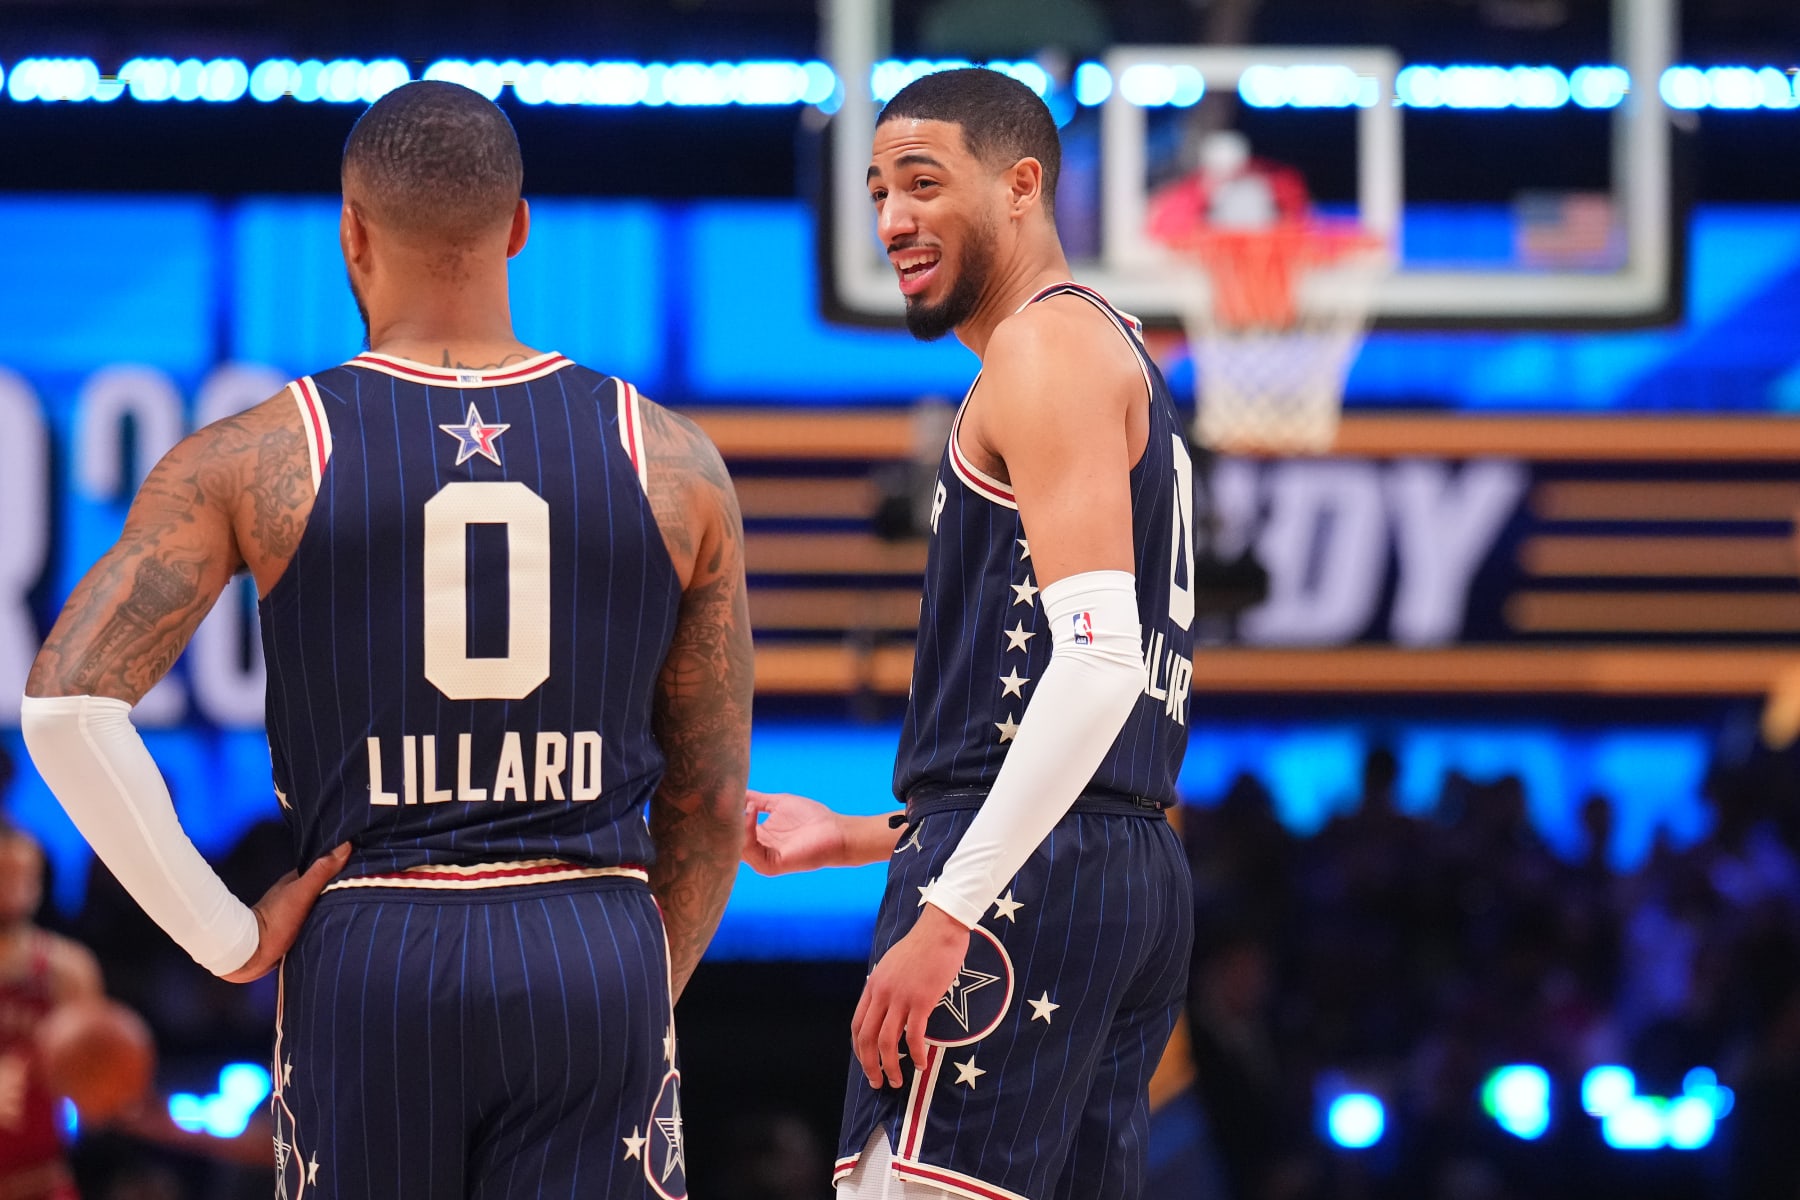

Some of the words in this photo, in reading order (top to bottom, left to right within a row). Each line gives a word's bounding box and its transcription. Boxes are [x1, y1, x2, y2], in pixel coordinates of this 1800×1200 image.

[424, 481, 550, 700] 0
[1169, 432, 1195, 632] 0
[367, 730, 602, 805] LILLARD
